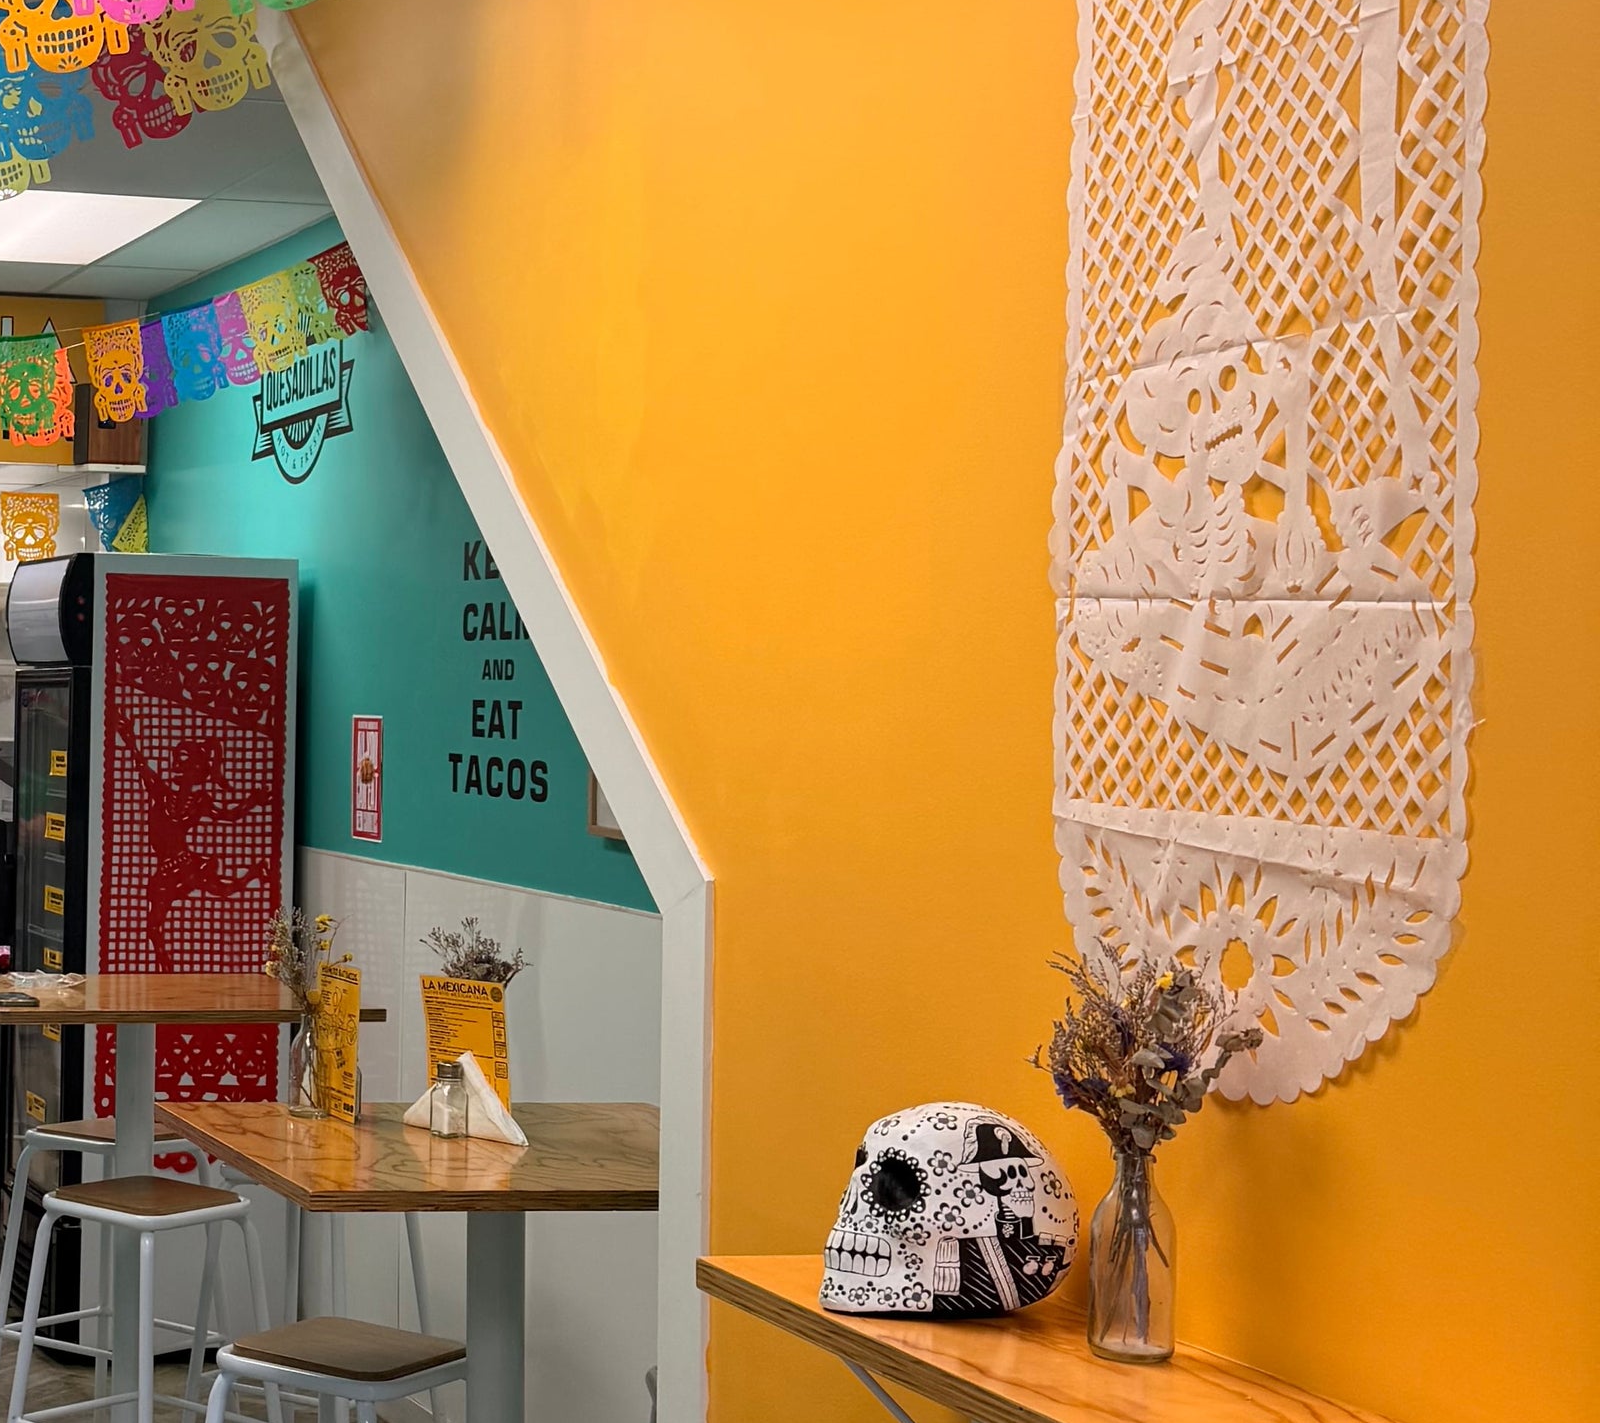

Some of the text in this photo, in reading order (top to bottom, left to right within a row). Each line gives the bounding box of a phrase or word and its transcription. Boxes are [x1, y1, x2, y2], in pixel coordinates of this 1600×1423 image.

[266, 347, 336, 412] QUESADILLAS
[463, 540, 501, 581] KE
[481, 658, 515, 681] AND
[471, 699, 523, 740] EAT
[448, 752, 549, 803] TACOS
[422, 979, 489, 996] LA MEXICANA
